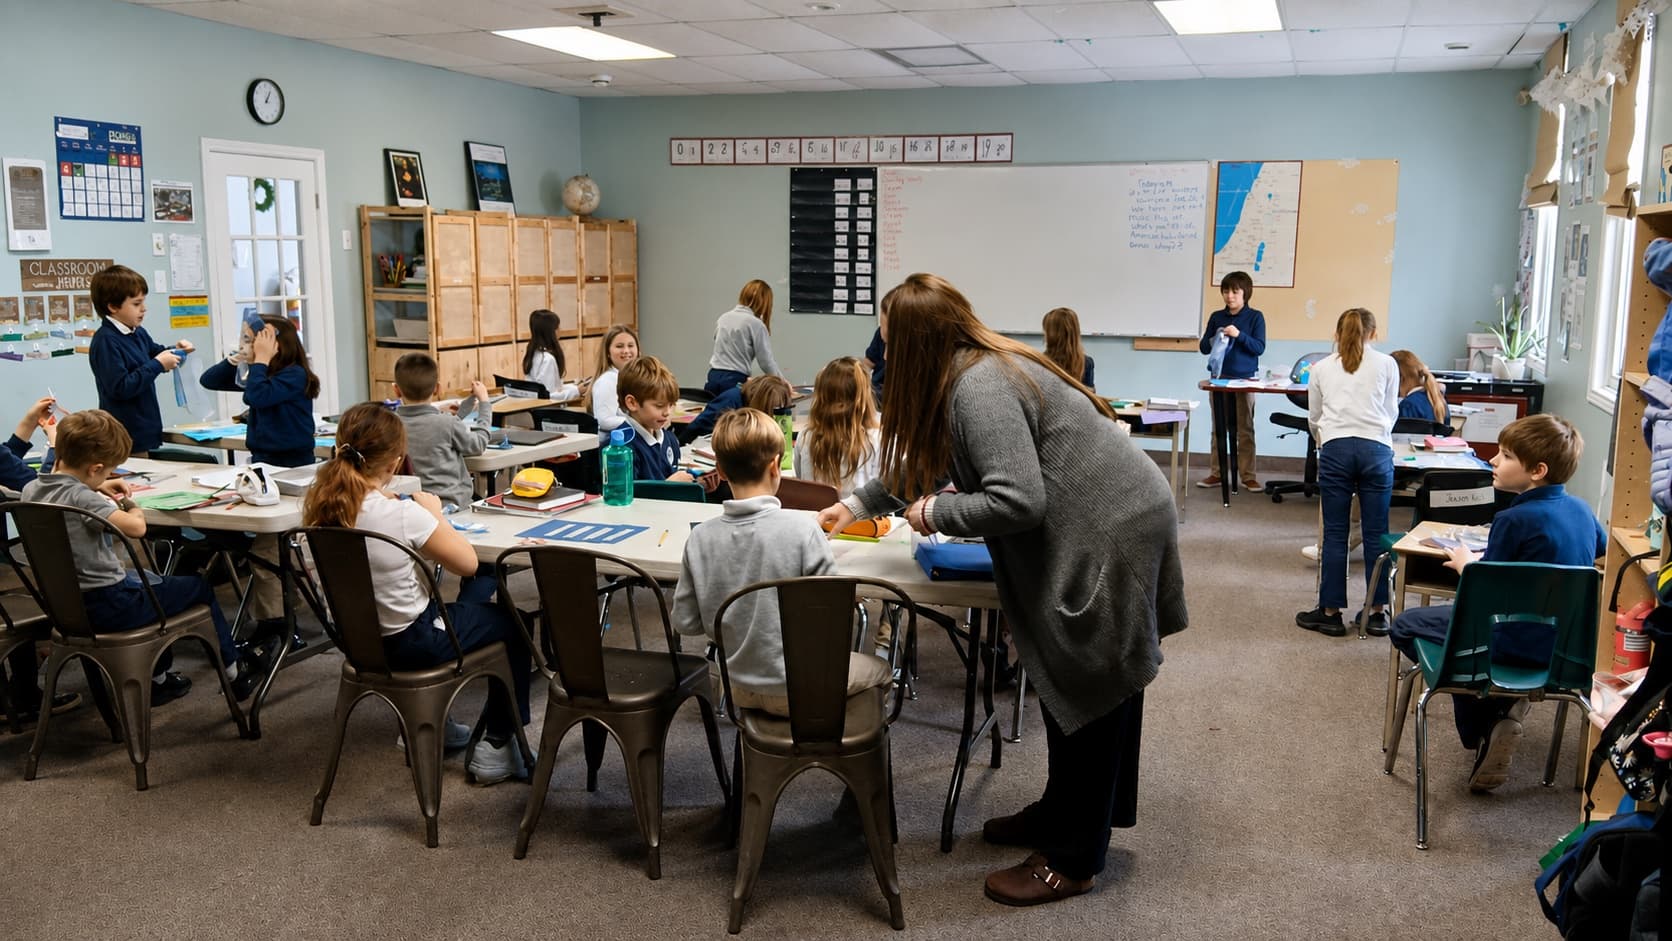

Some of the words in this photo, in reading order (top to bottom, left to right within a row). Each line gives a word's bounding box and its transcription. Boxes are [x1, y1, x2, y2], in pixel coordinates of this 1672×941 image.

[677, 142, 684, 155] 0
[708, 142, 715, 155] 2
[29, 261, 107, 276] CLASSROOM
